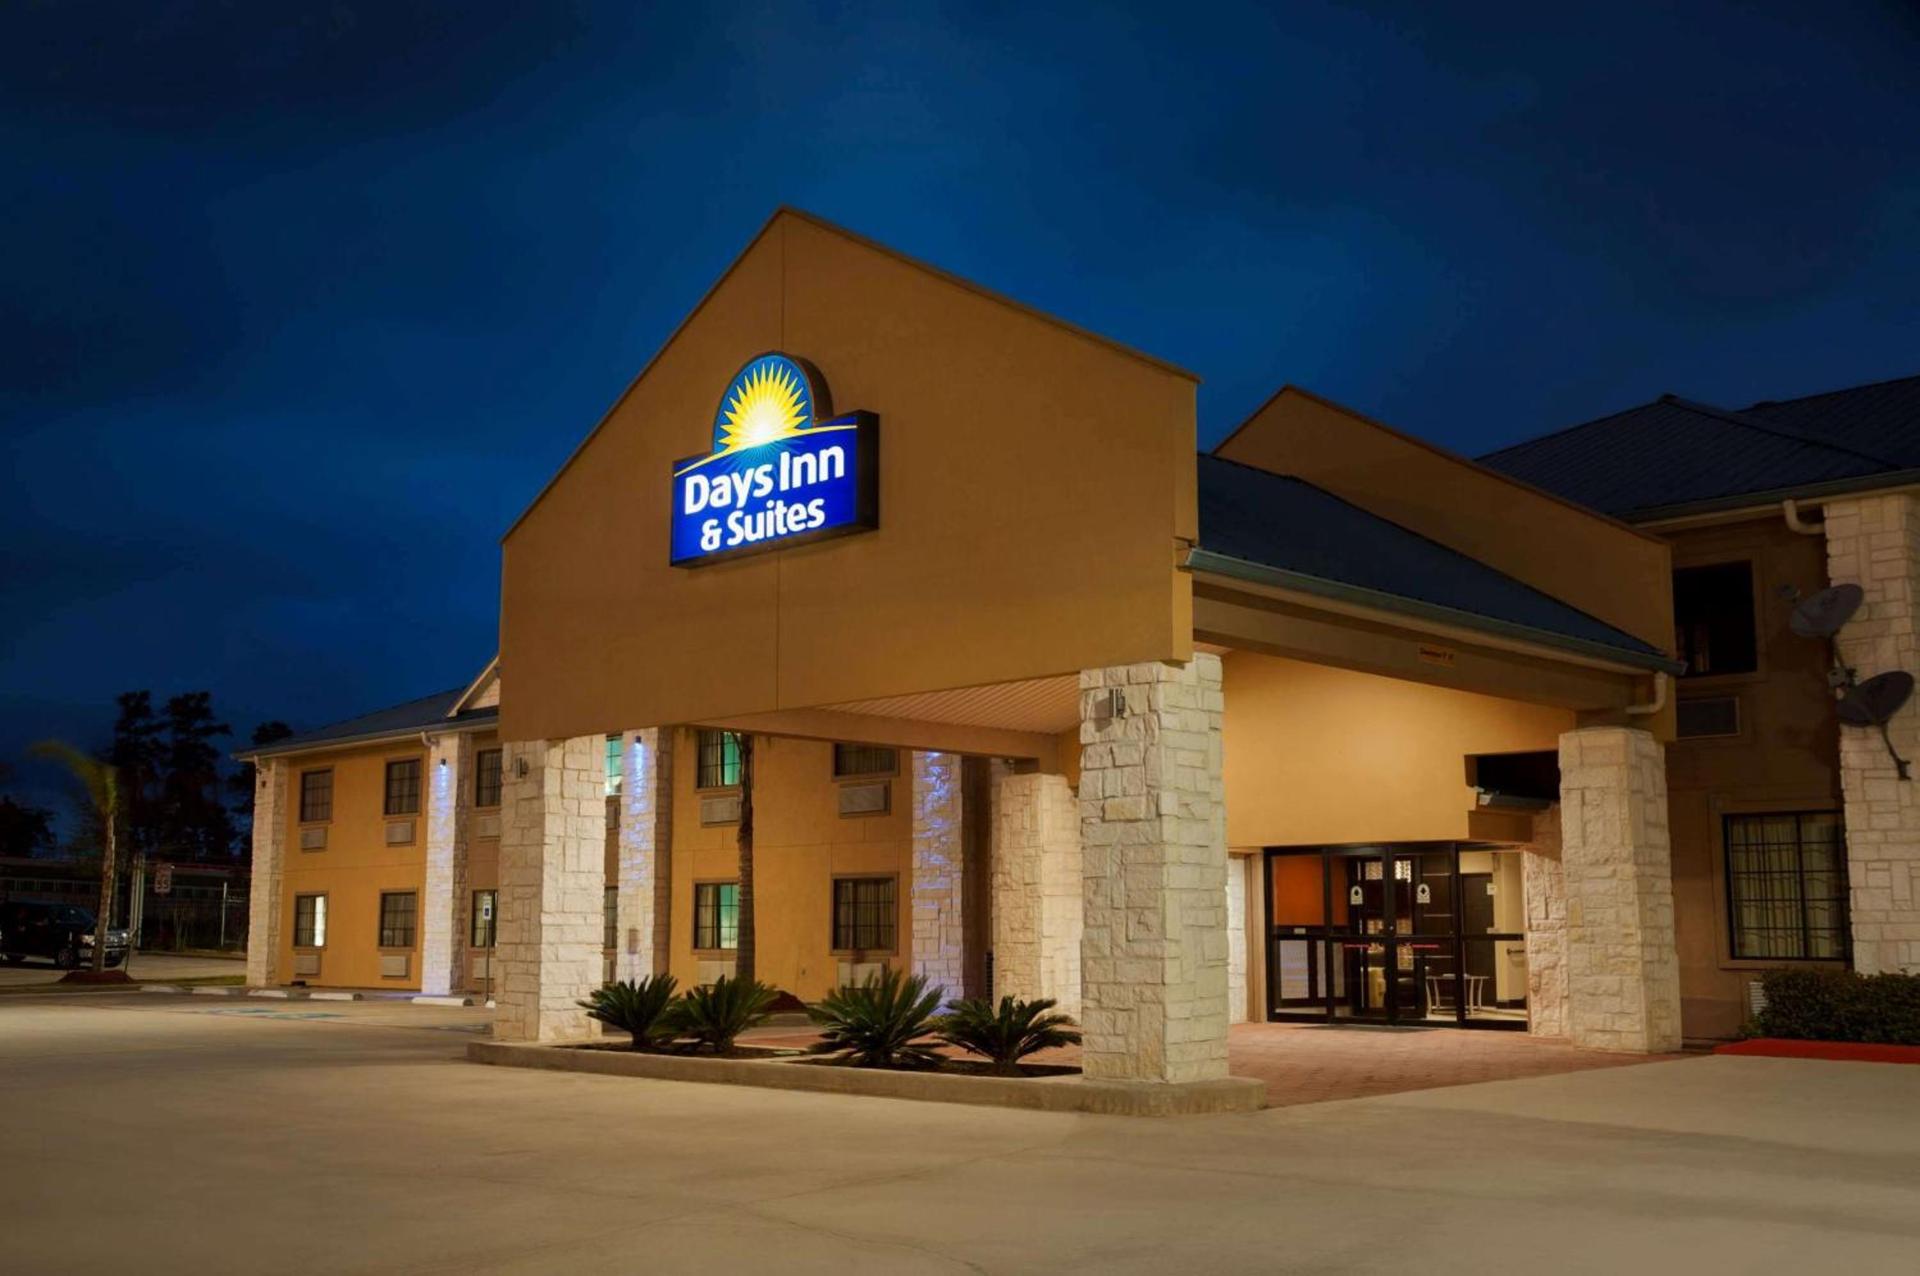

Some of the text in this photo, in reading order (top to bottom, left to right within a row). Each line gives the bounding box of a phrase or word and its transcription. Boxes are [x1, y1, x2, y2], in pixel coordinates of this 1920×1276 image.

[684, 445, 845, 515] Days Inn
[700, 498, 825, 551] & Suites
